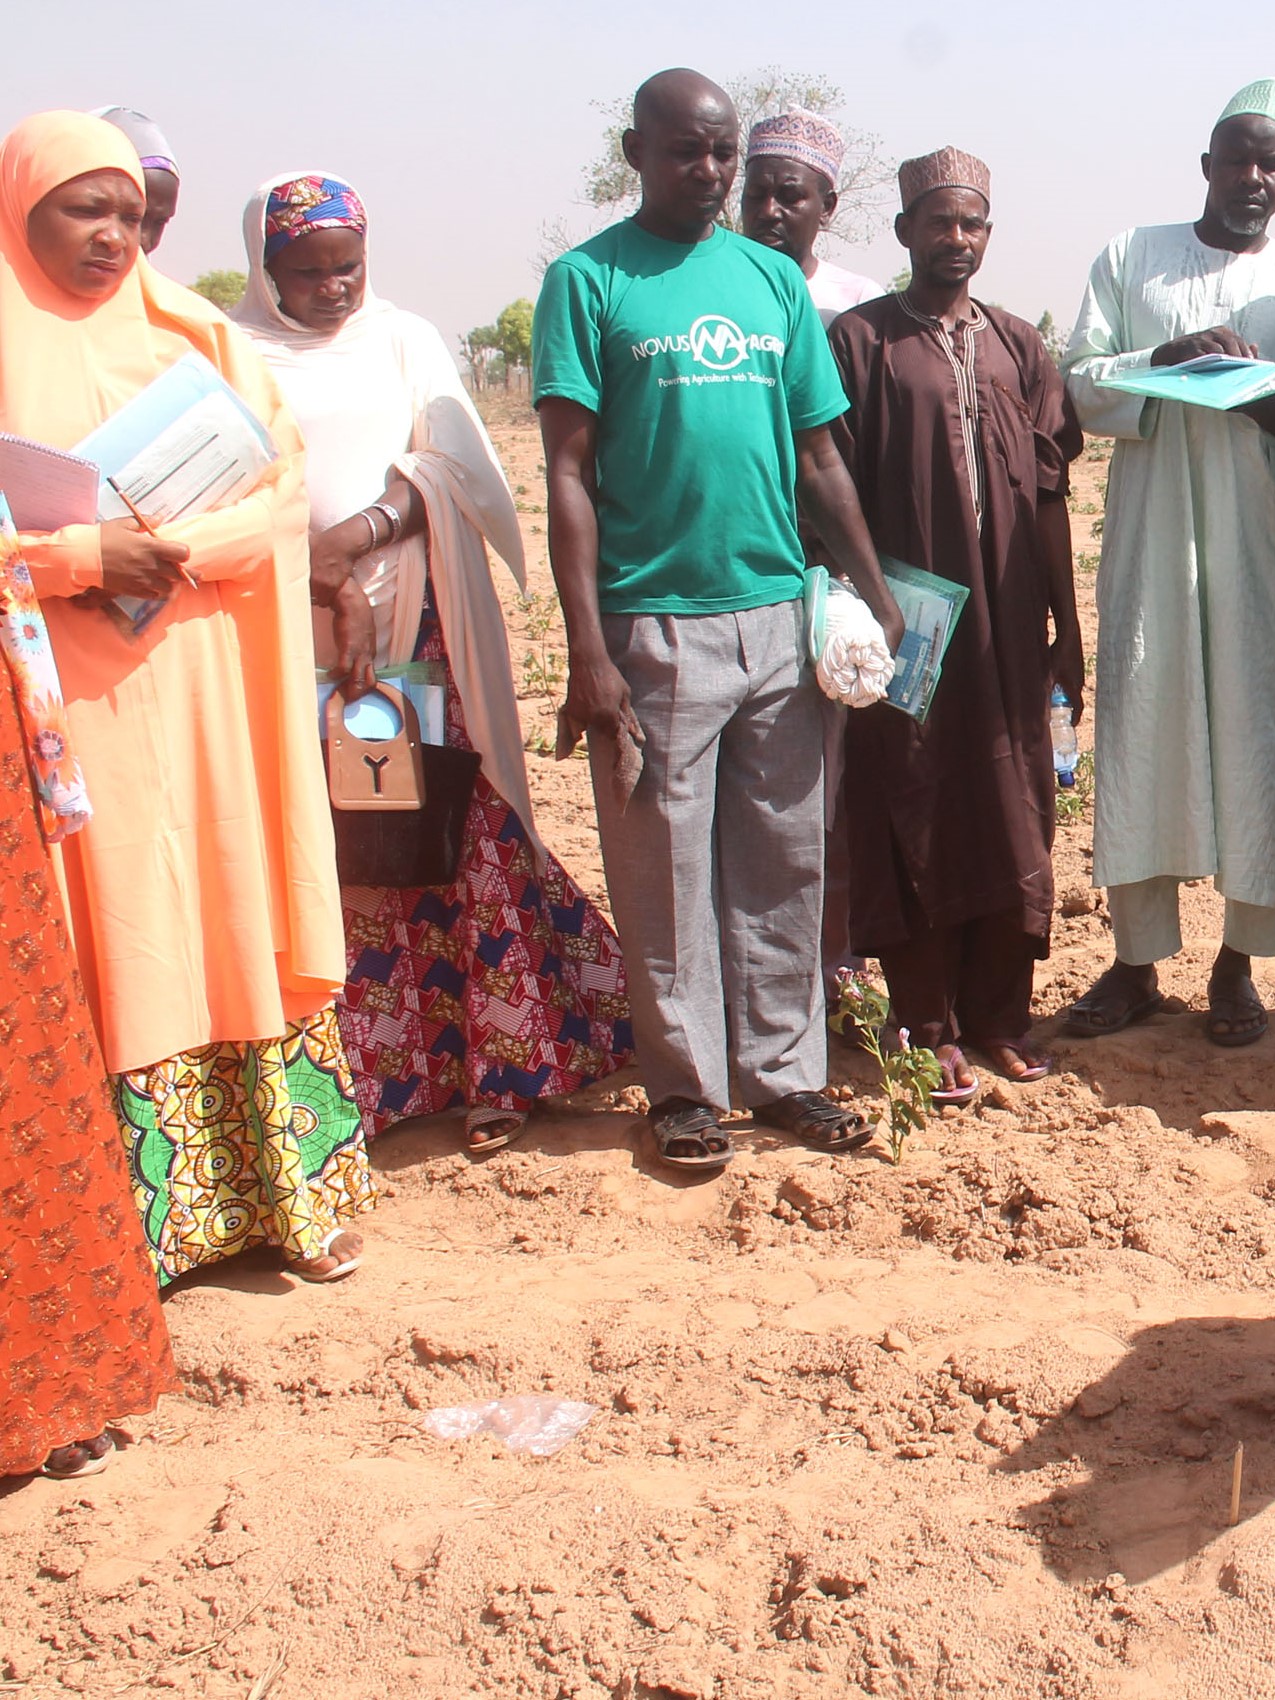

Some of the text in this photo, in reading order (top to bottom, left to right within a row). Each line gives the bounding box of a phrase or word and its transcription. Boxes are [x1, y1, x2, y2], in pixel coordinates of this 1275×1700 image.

[632, 335, 690, 361] NOVUS
[658, 375, 690, 388] Powering
[692, 374, 730, 385] Agriculture
[731, 372, 747, 382] with
